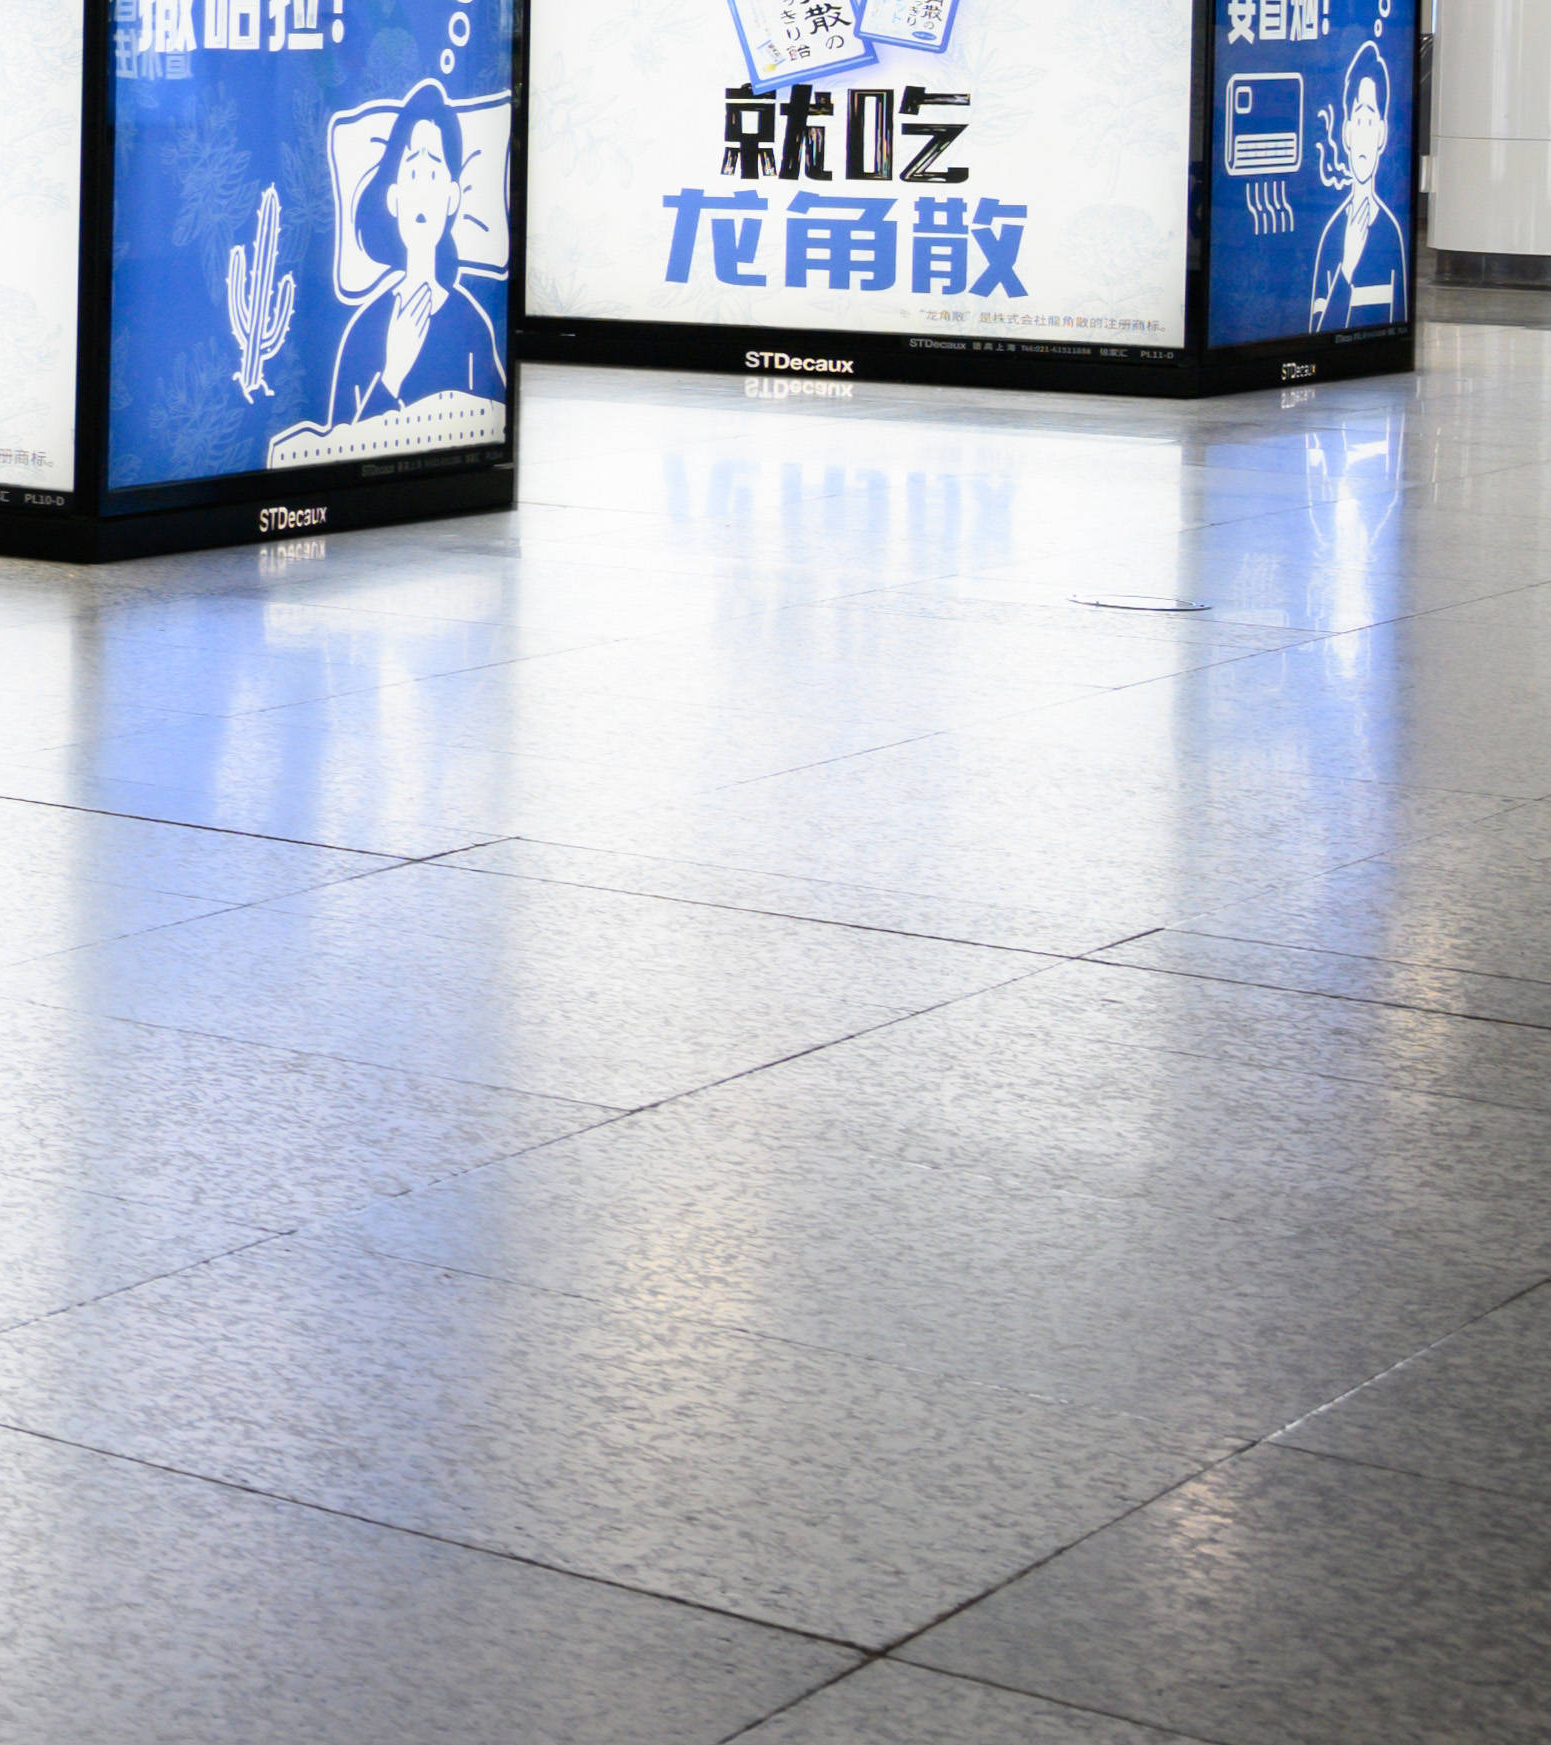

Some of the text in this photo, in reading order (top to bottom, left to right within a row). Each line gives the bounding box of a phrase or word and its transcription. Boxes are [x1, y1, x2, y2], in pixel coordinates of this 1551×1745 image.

[719, 82, 972, 184] 就吃
[661, 187, 1029, 299] 龙角散
[909, 338, 967, 350] STDecaux
[744, 349, 855, 375] STDecaux
[23, 492, 65, 507] PL10-D
[259, 506, 328, 533] STDecaux
